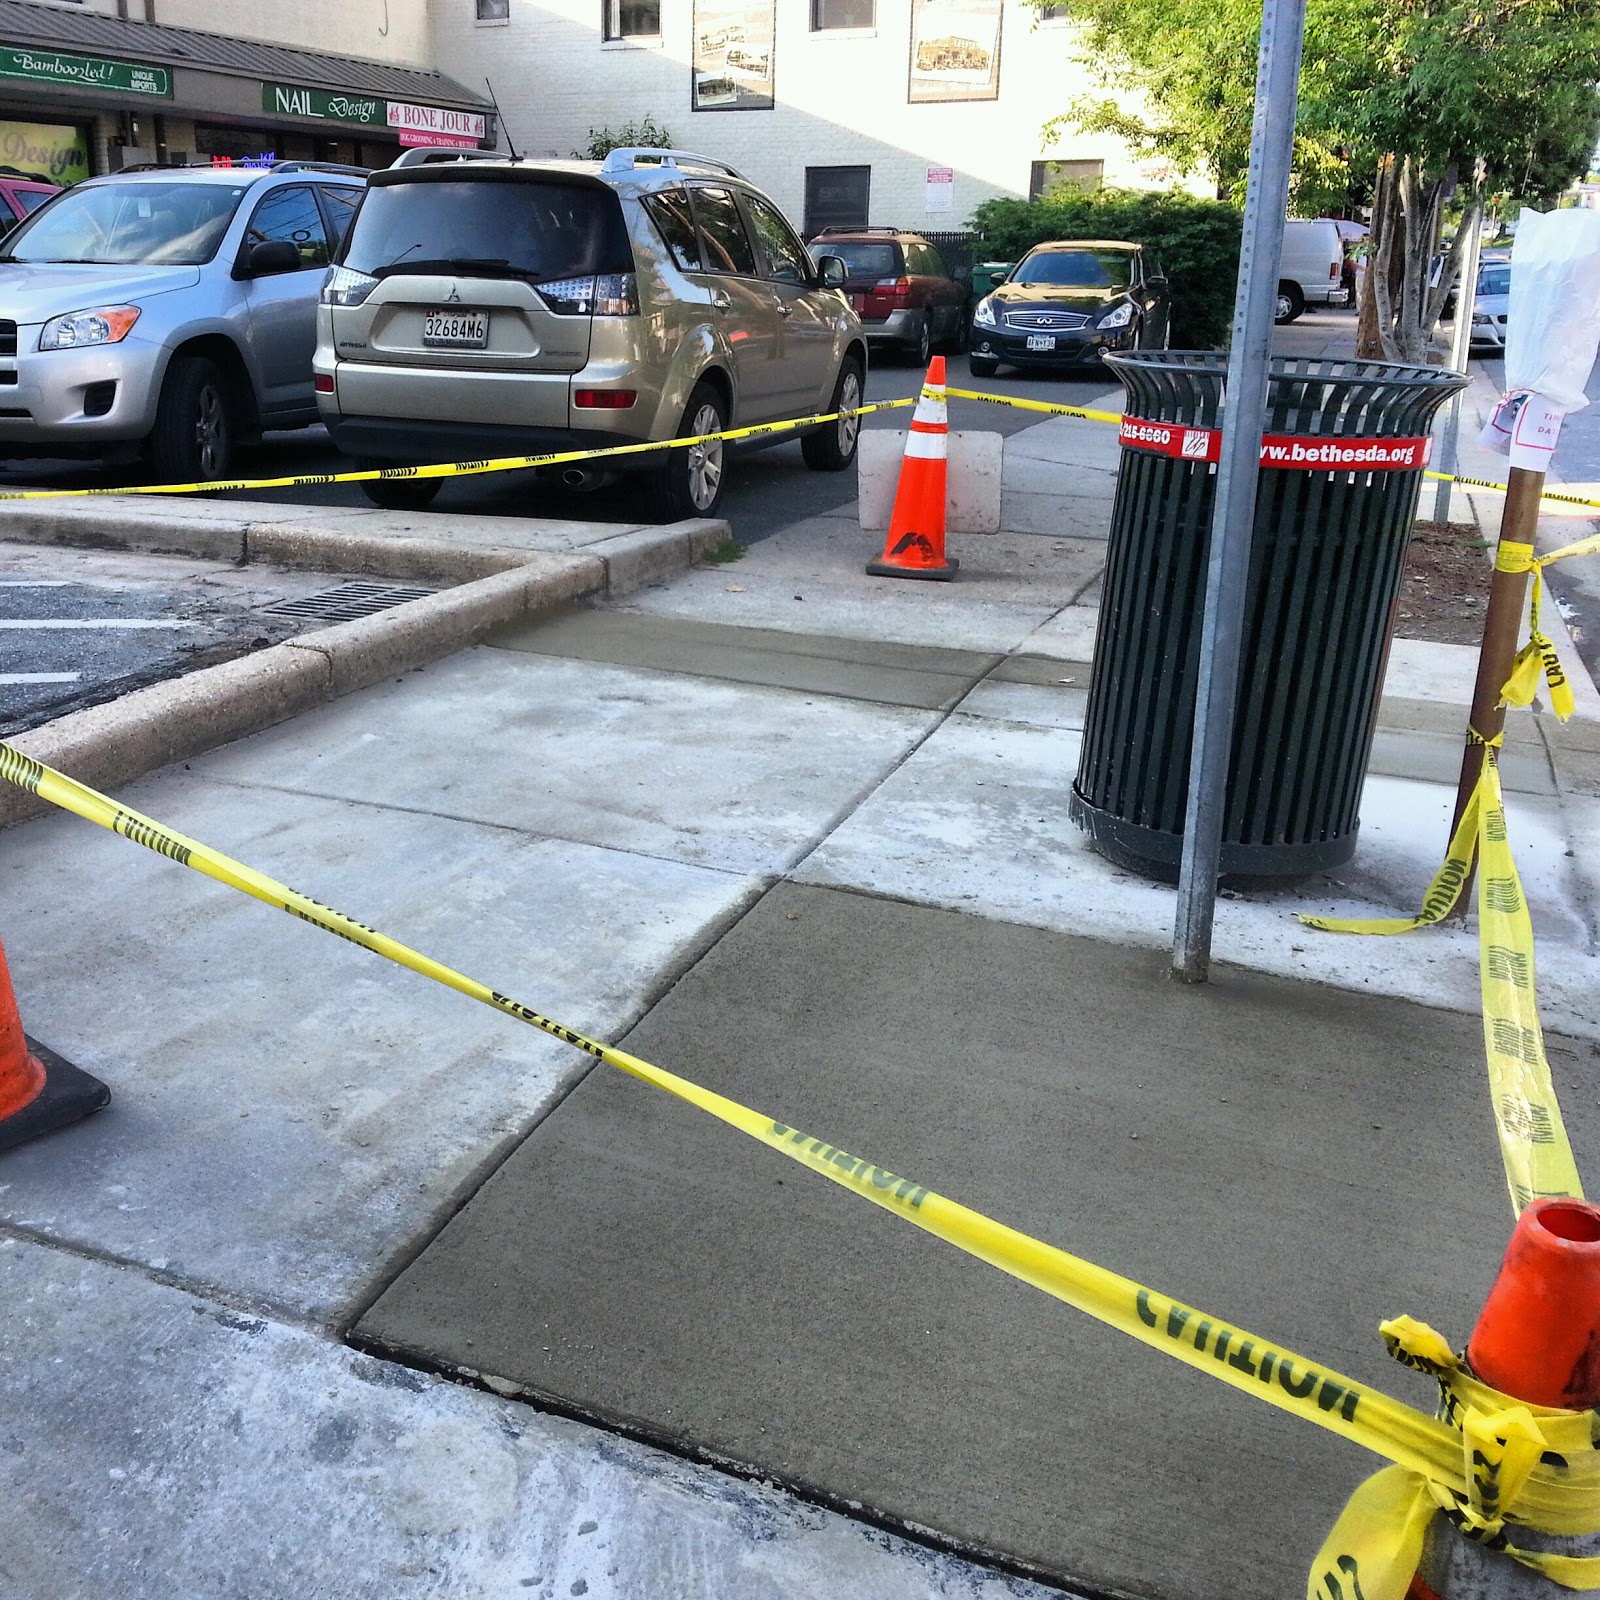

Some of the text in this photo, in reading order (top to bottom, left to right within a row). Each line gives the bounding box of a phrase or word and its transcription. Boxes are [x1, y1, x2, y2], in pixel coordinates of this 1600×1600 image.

[13, 54, 114, 83] Bamboozled!
[131, 70, 155, 81] UNIQUE
[130, 80, 157, 91] IMPORTS
[275, 87, 376, 122] NAIL Design
[404, 105, 471, 132] BONE JOUR
[3, 131, 87, 176] Design
[425, 318, 484, 339] 32684M6
